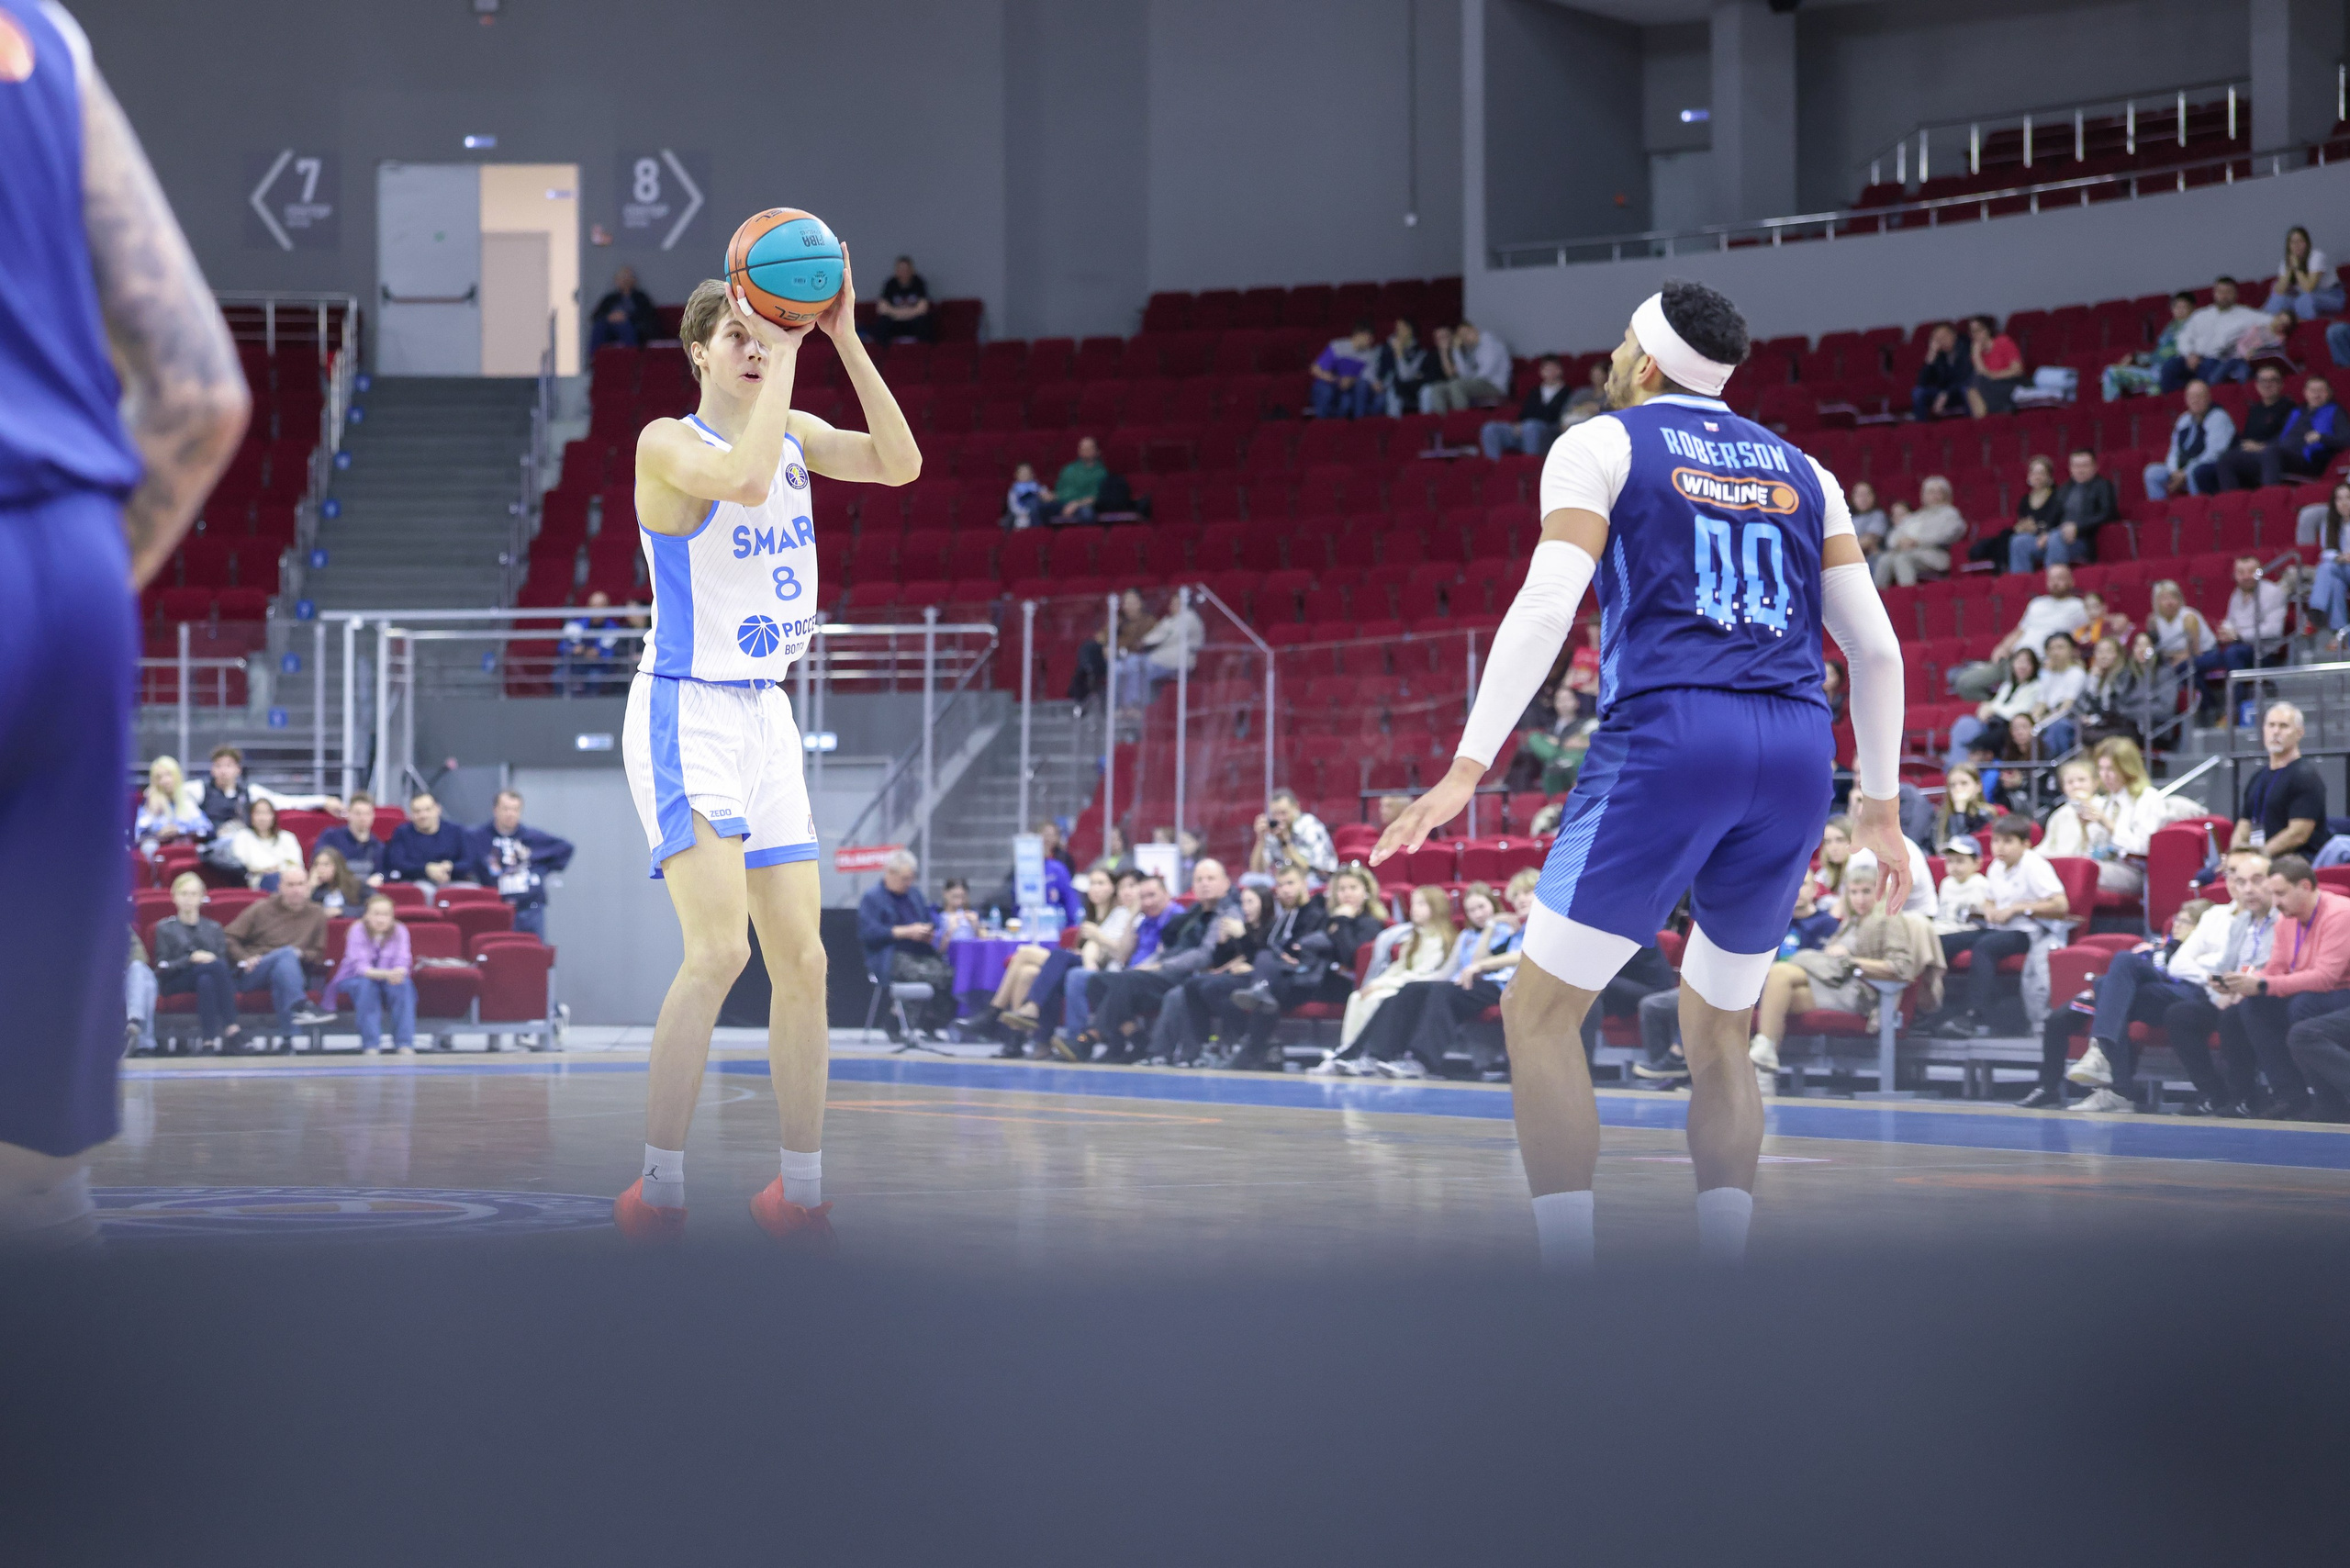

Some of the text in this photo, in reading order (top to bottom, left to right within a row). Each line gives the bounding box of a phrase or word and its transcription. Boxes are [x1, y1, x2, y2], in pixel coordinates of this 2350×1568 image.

[296, 157, 321, 203] 7
[633, 157, 660, 203] 8
[1660, 427, 1790, 473] ROBERSON
[1682, 474, 1768, 505] WINLINE
[772, 566, 802, 601] 8
[1695, 514, 1790, 633] 00
[782, 615, 816, 638] РОССЕ
[709, 808, 733, 818] ZEDO
